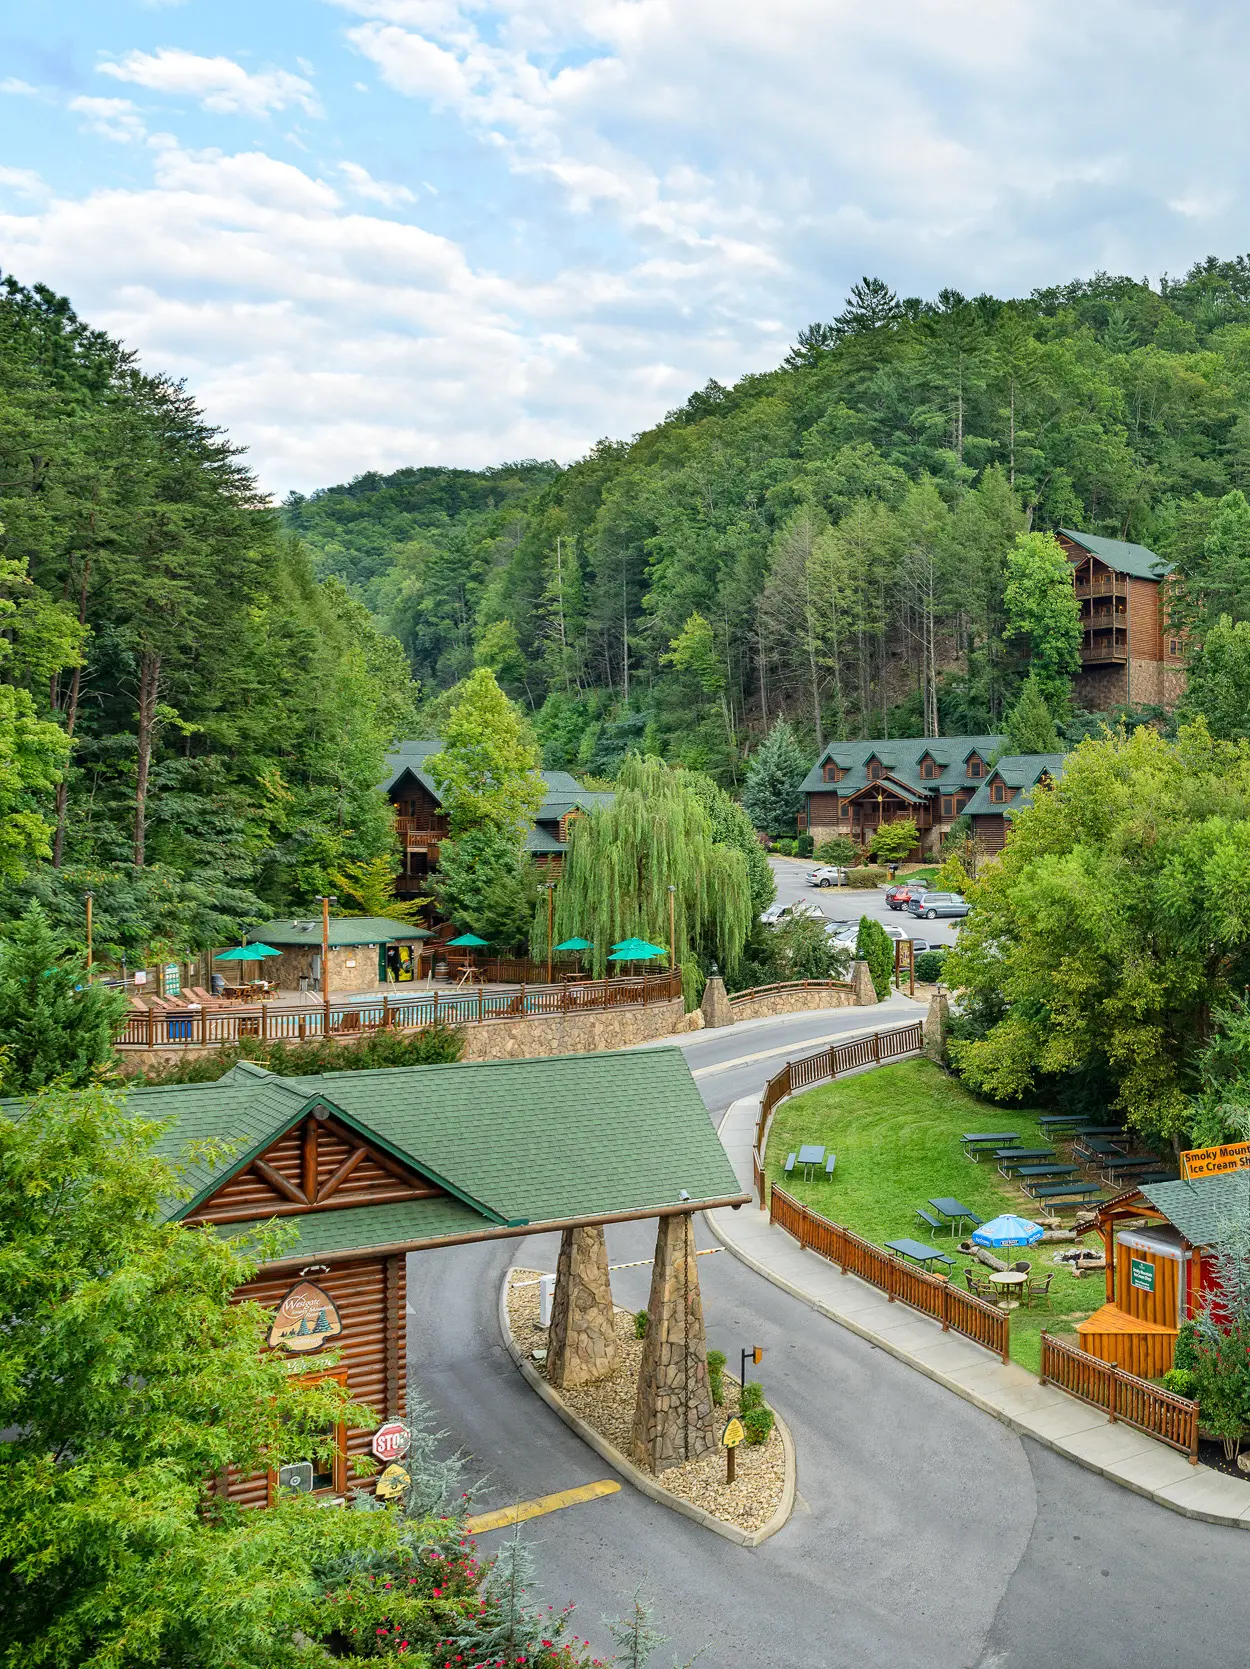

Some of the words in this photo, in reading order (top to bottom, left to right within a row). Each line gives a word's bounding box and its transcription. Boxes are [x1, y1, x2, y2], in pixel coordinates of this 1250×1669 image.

[1185, 1150, 1217, 1162] Smoky
[1190, 1164, 1204, 1173] Ice
[1206, 1160, 1237, 1171] Cream
[284, 1293, 321, 1310] Westgate
